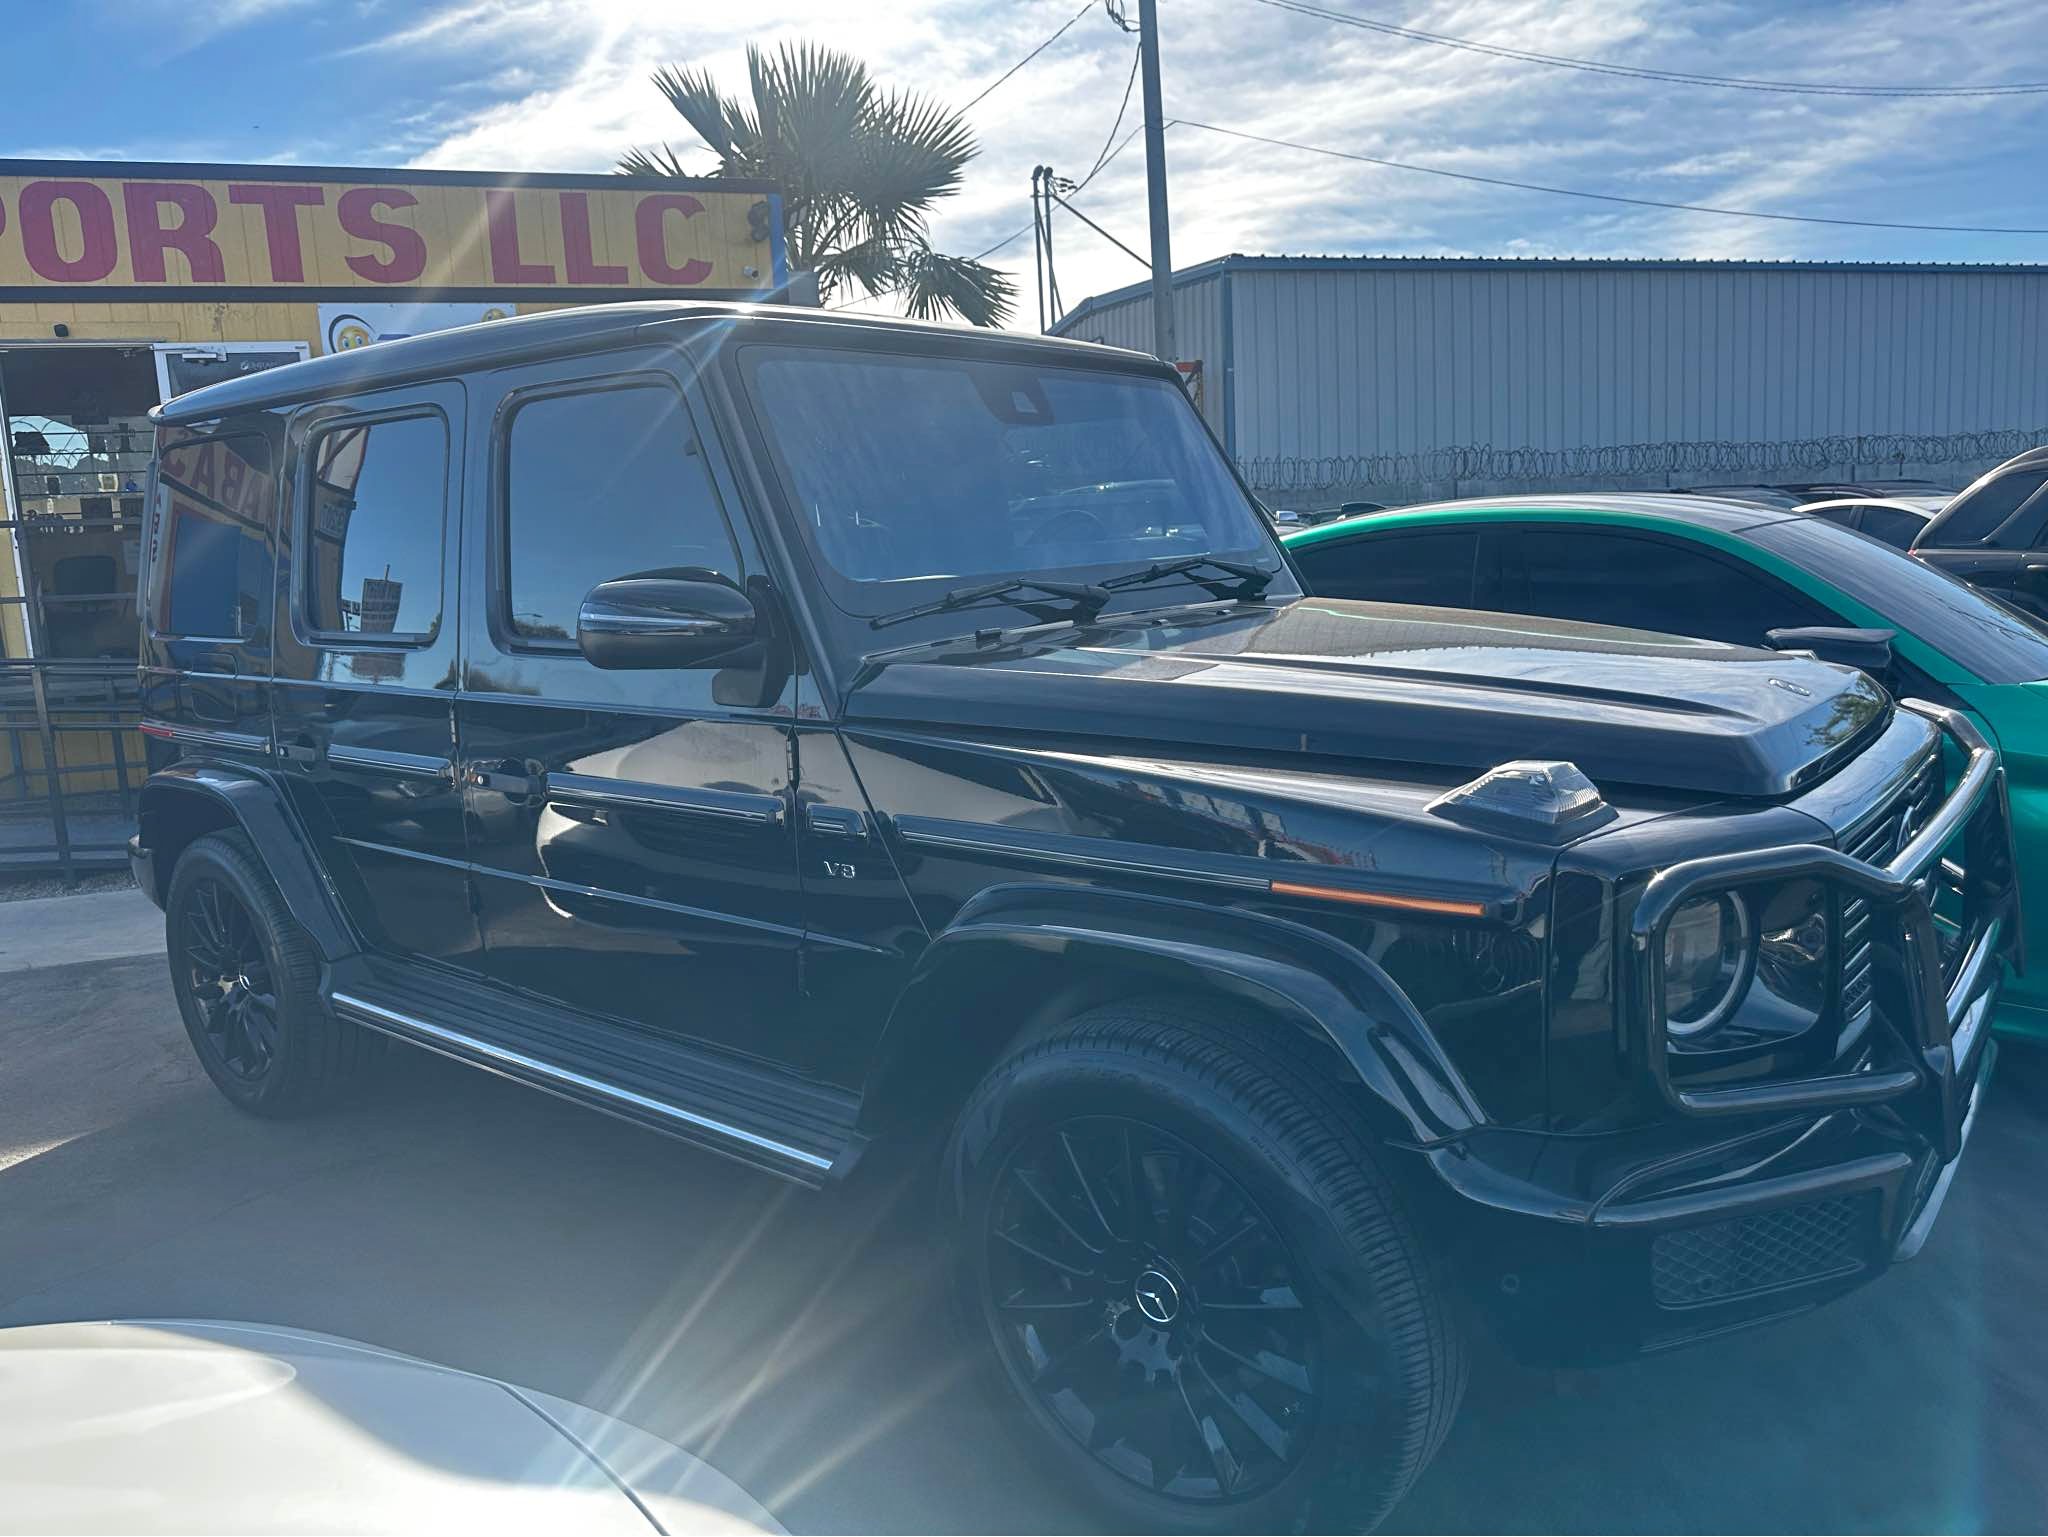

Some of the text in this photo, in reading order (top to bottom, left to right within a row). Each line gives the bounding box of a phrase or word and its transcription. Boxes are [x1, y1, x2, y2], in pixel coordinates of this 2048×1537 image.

[0, 181, 714, 285] ORTS LLC
[823, 861, 856, 879] V8
